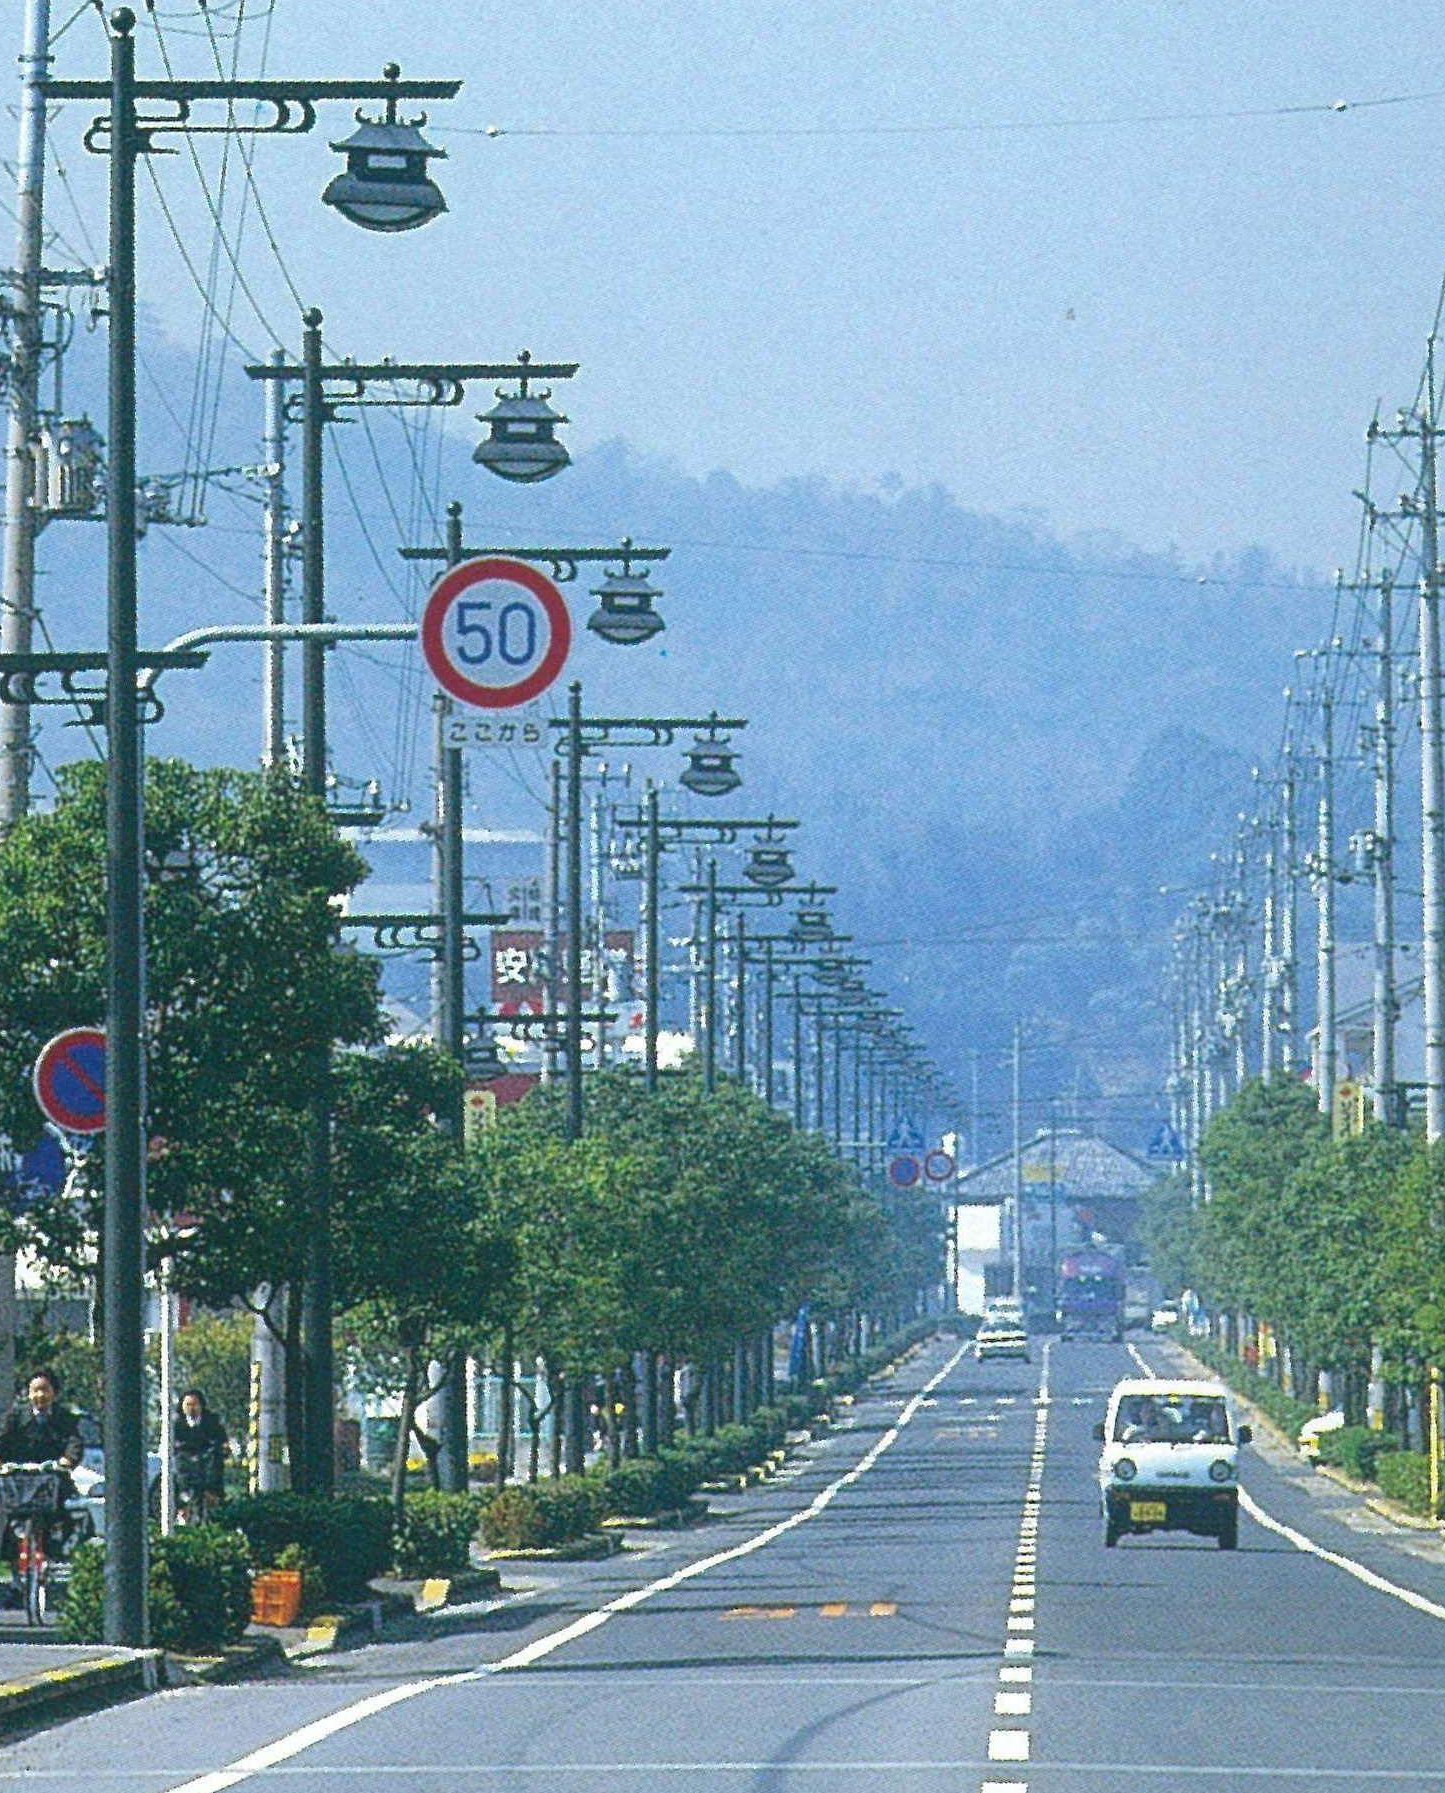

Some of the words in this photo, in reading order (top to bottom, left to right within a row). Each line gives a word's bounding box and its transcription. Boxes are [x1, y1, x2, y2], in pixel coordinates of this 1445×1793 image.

[456, 601, 536, 666] 50
[450, 721, 541, 742] ここから
